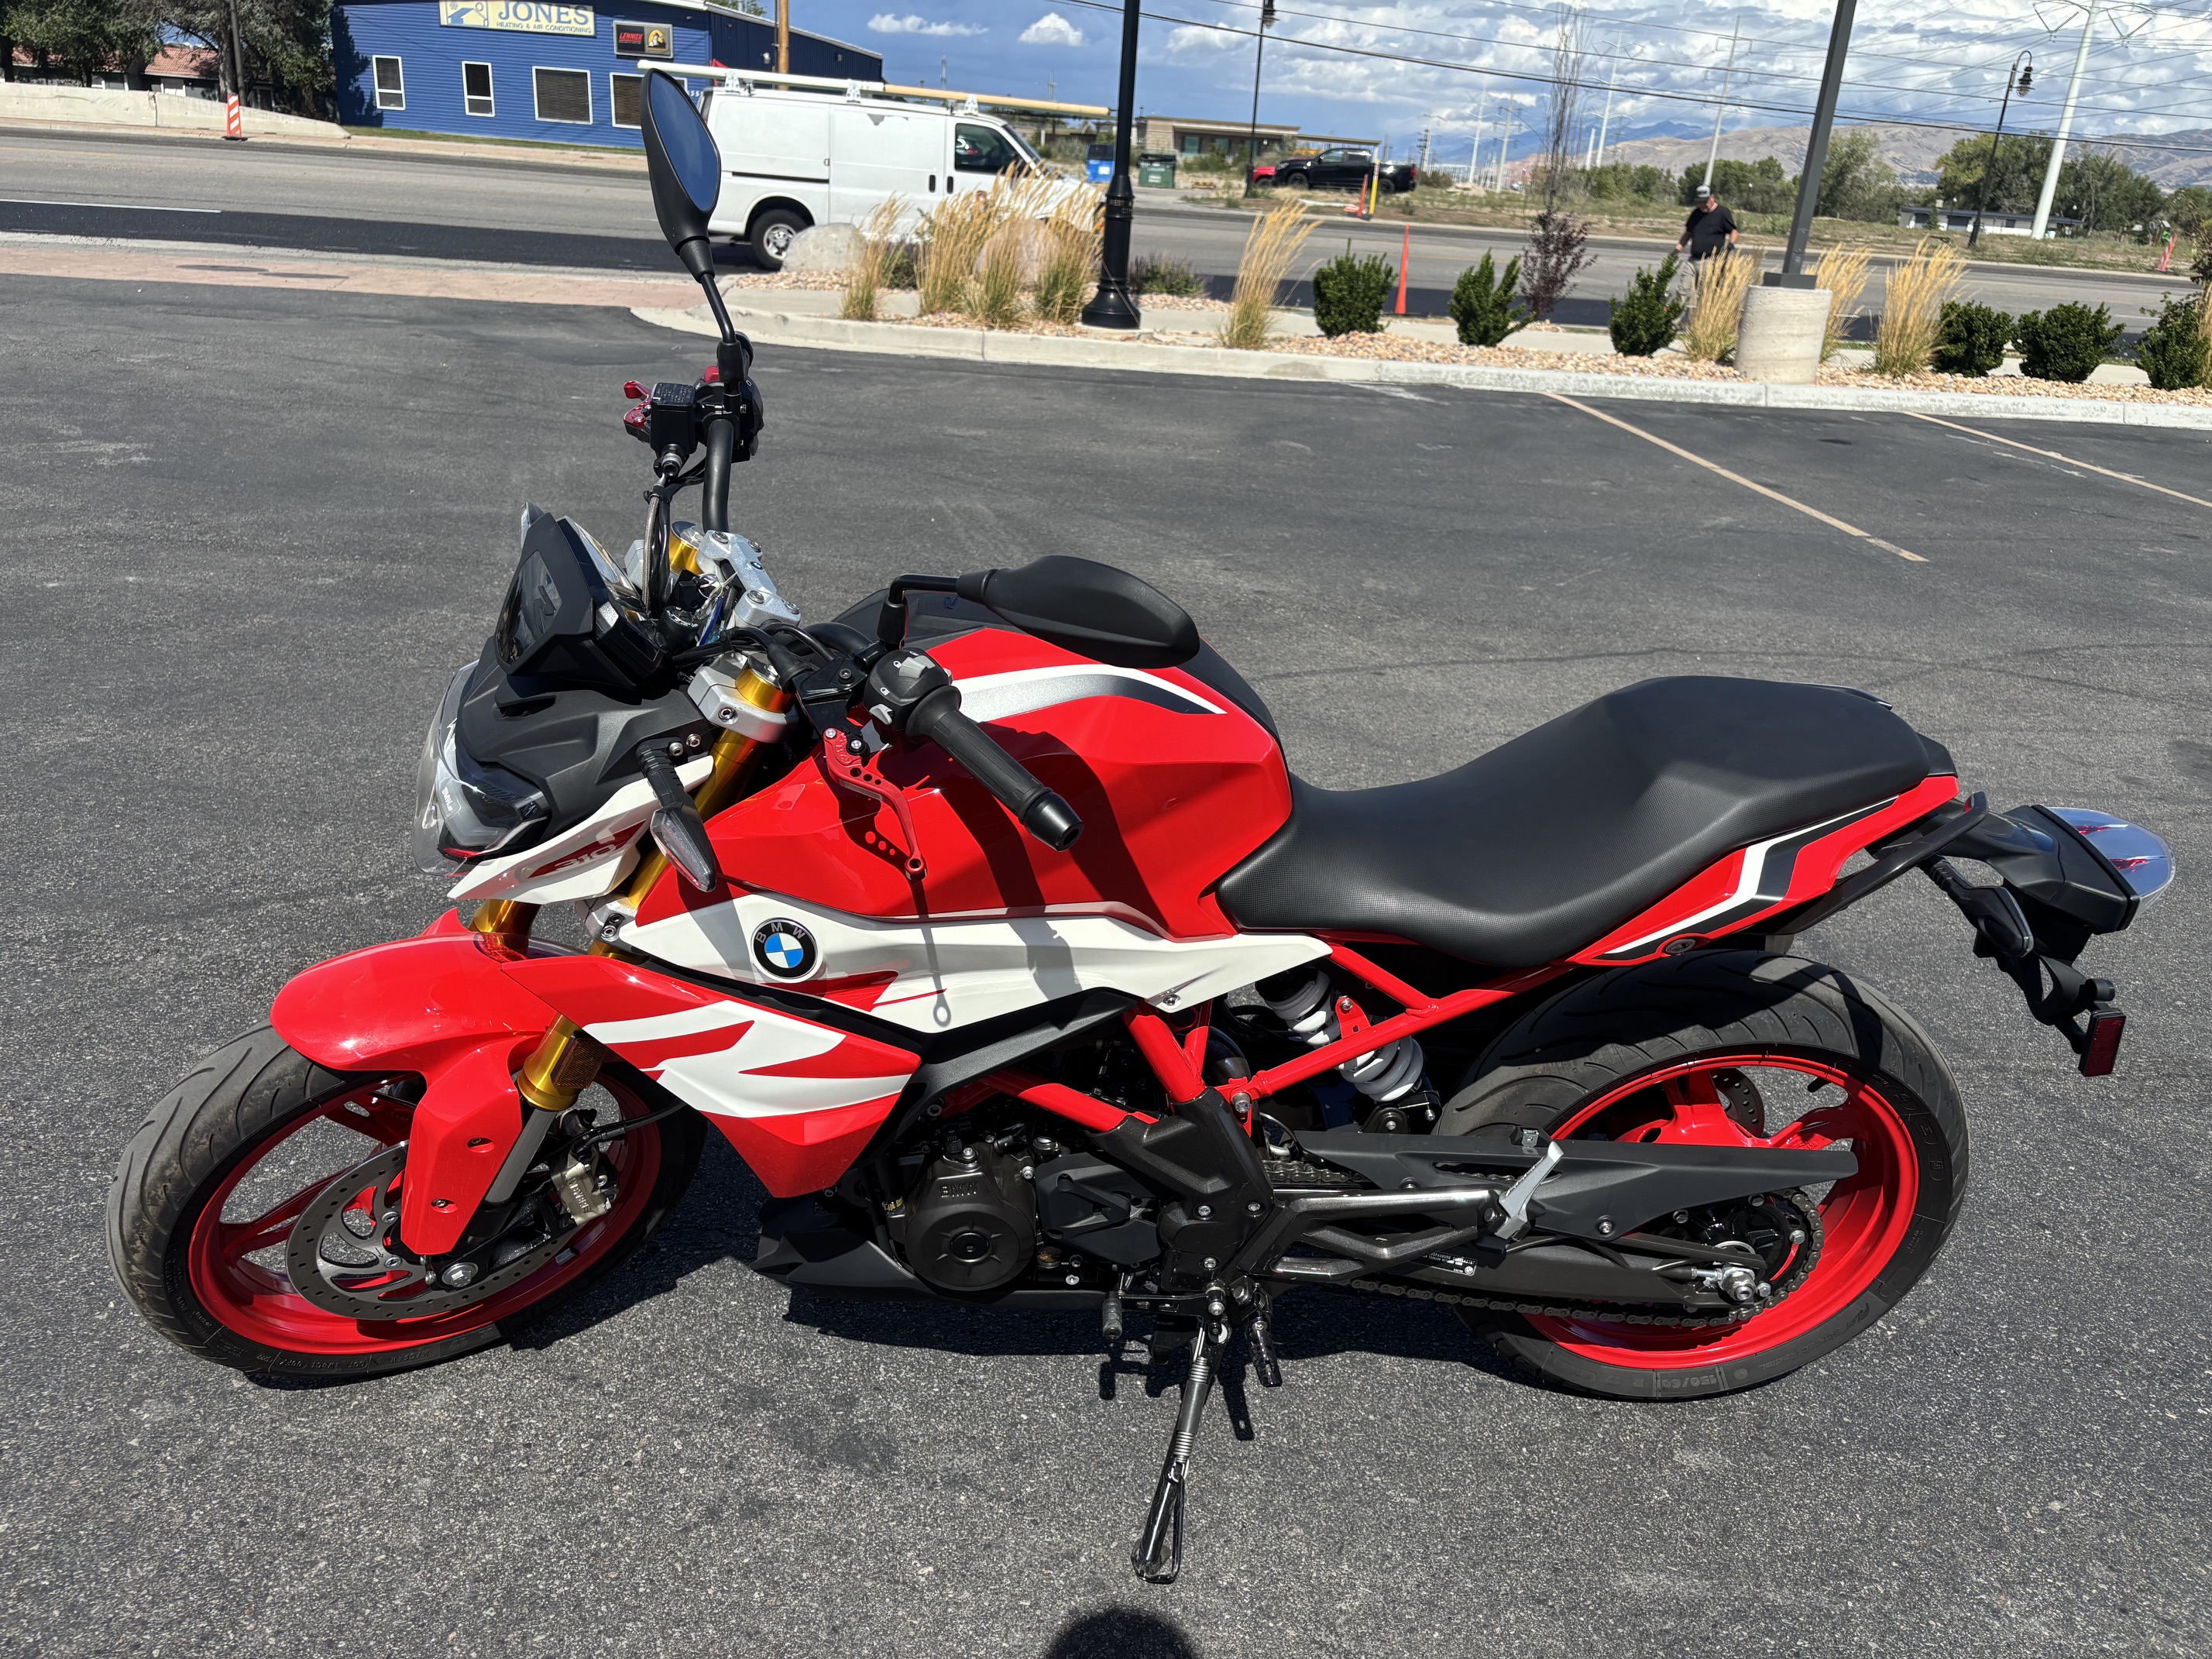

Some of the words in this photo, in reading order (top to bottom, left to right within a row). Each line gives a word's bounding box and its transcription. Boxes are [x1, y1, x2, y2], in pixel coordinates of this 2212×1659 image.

[498, 0, 589, 26] JONES
[545, 24, 592, 34] CONDITIONING
[619, 32, 644, 42] LENNOX
[755, 922, 805, 944] BMW
[940, 1181, 979, 1198] BMW
